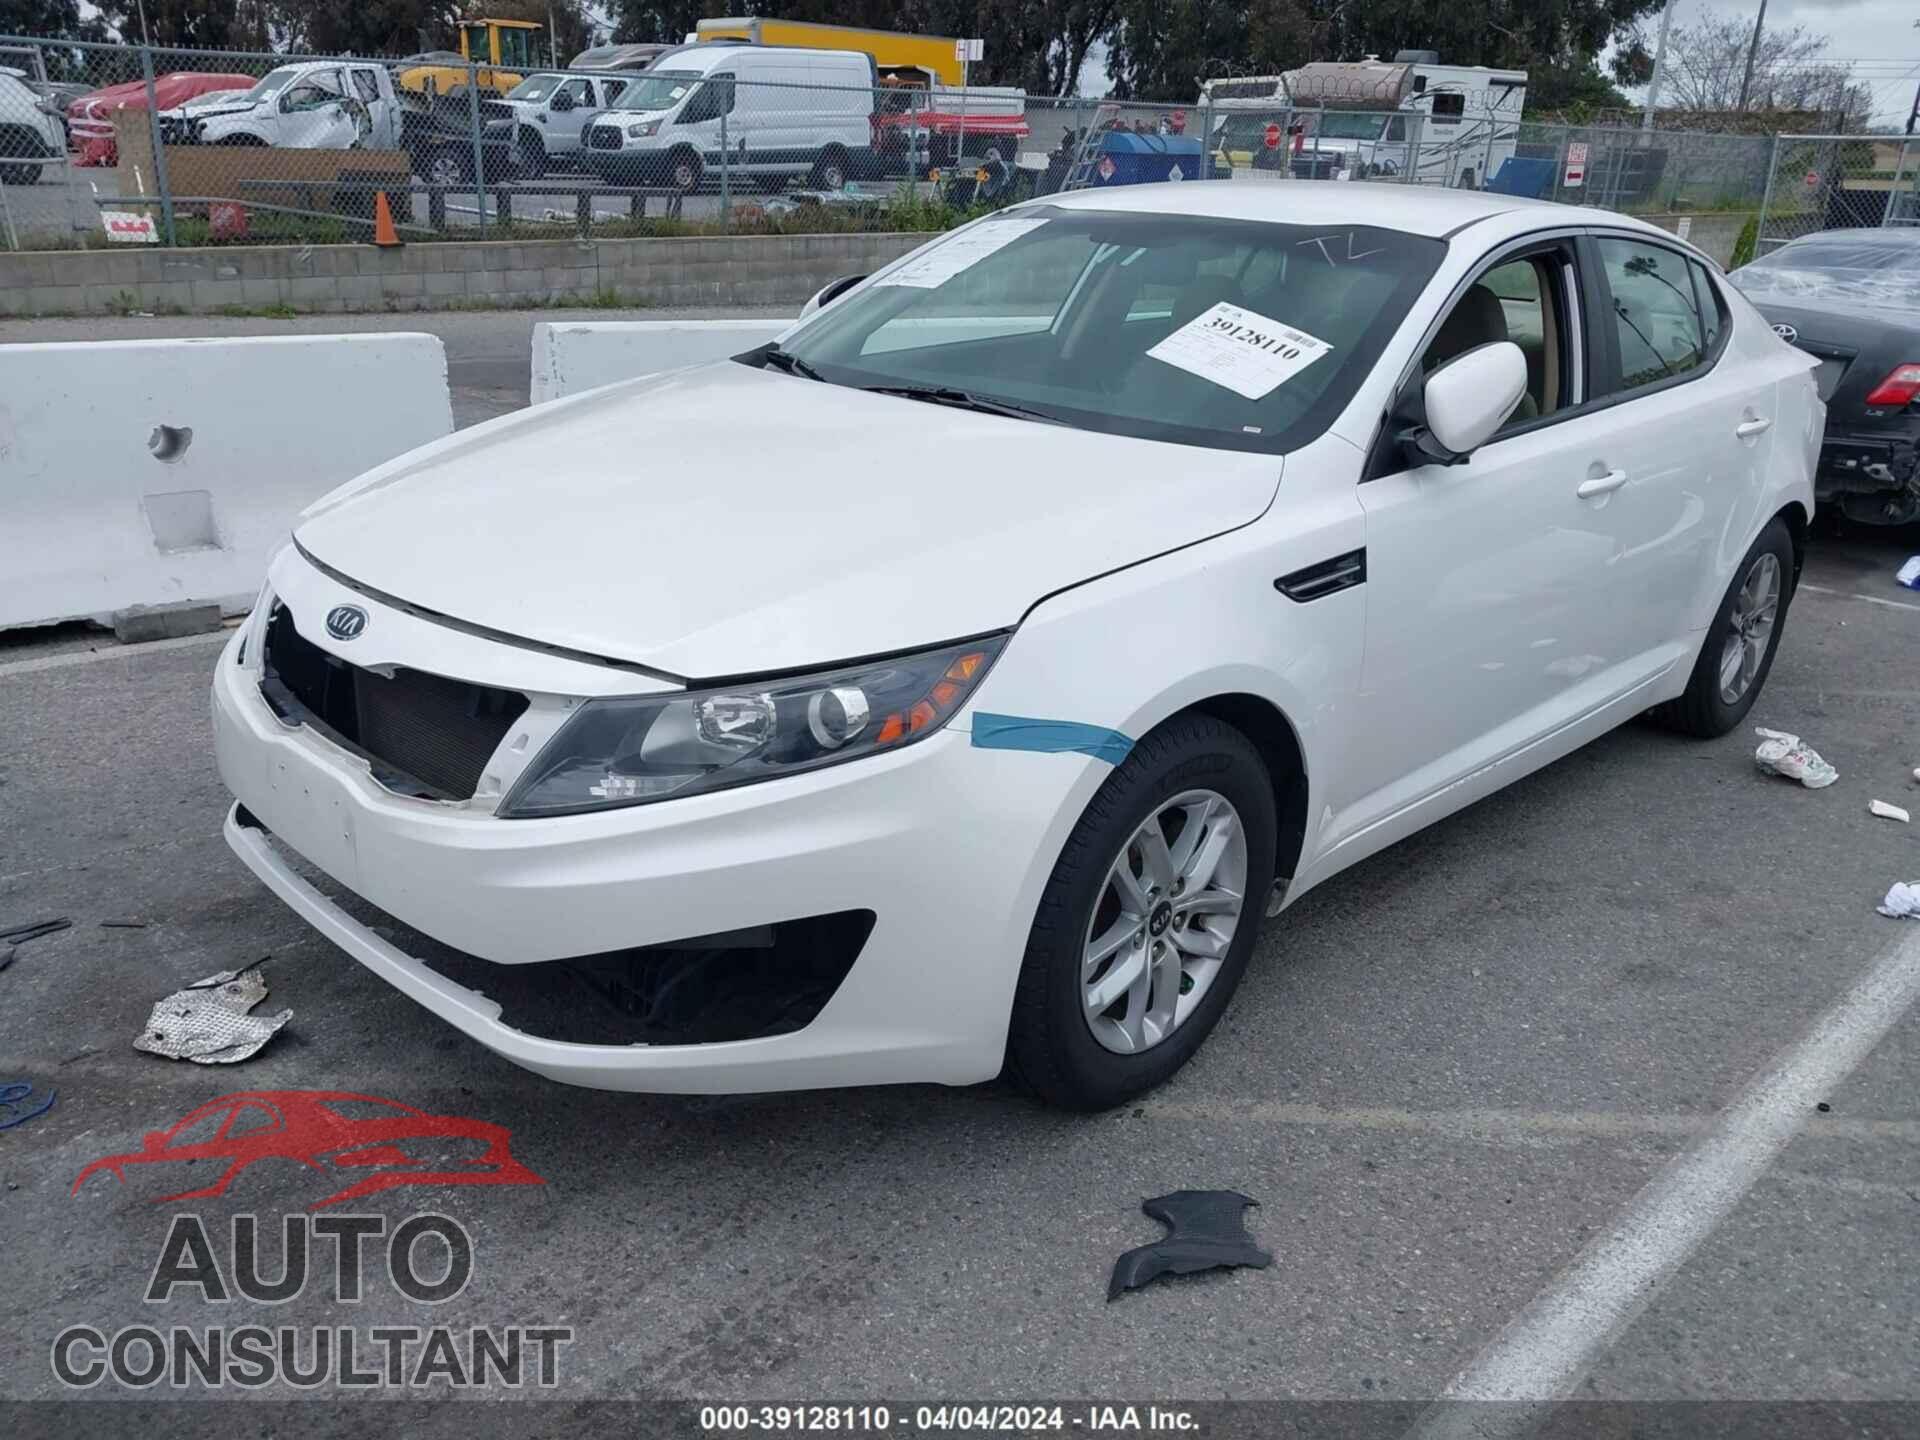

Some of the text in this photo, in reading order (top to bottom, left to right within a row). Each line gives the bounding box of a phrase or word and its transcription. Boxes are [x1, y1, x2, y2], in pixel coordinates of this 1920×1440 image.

[1203, 316, 1302, 361] 39128110
[328, 607, 360, 635] KIA
[1152, 909, 1171, 932] KIA
